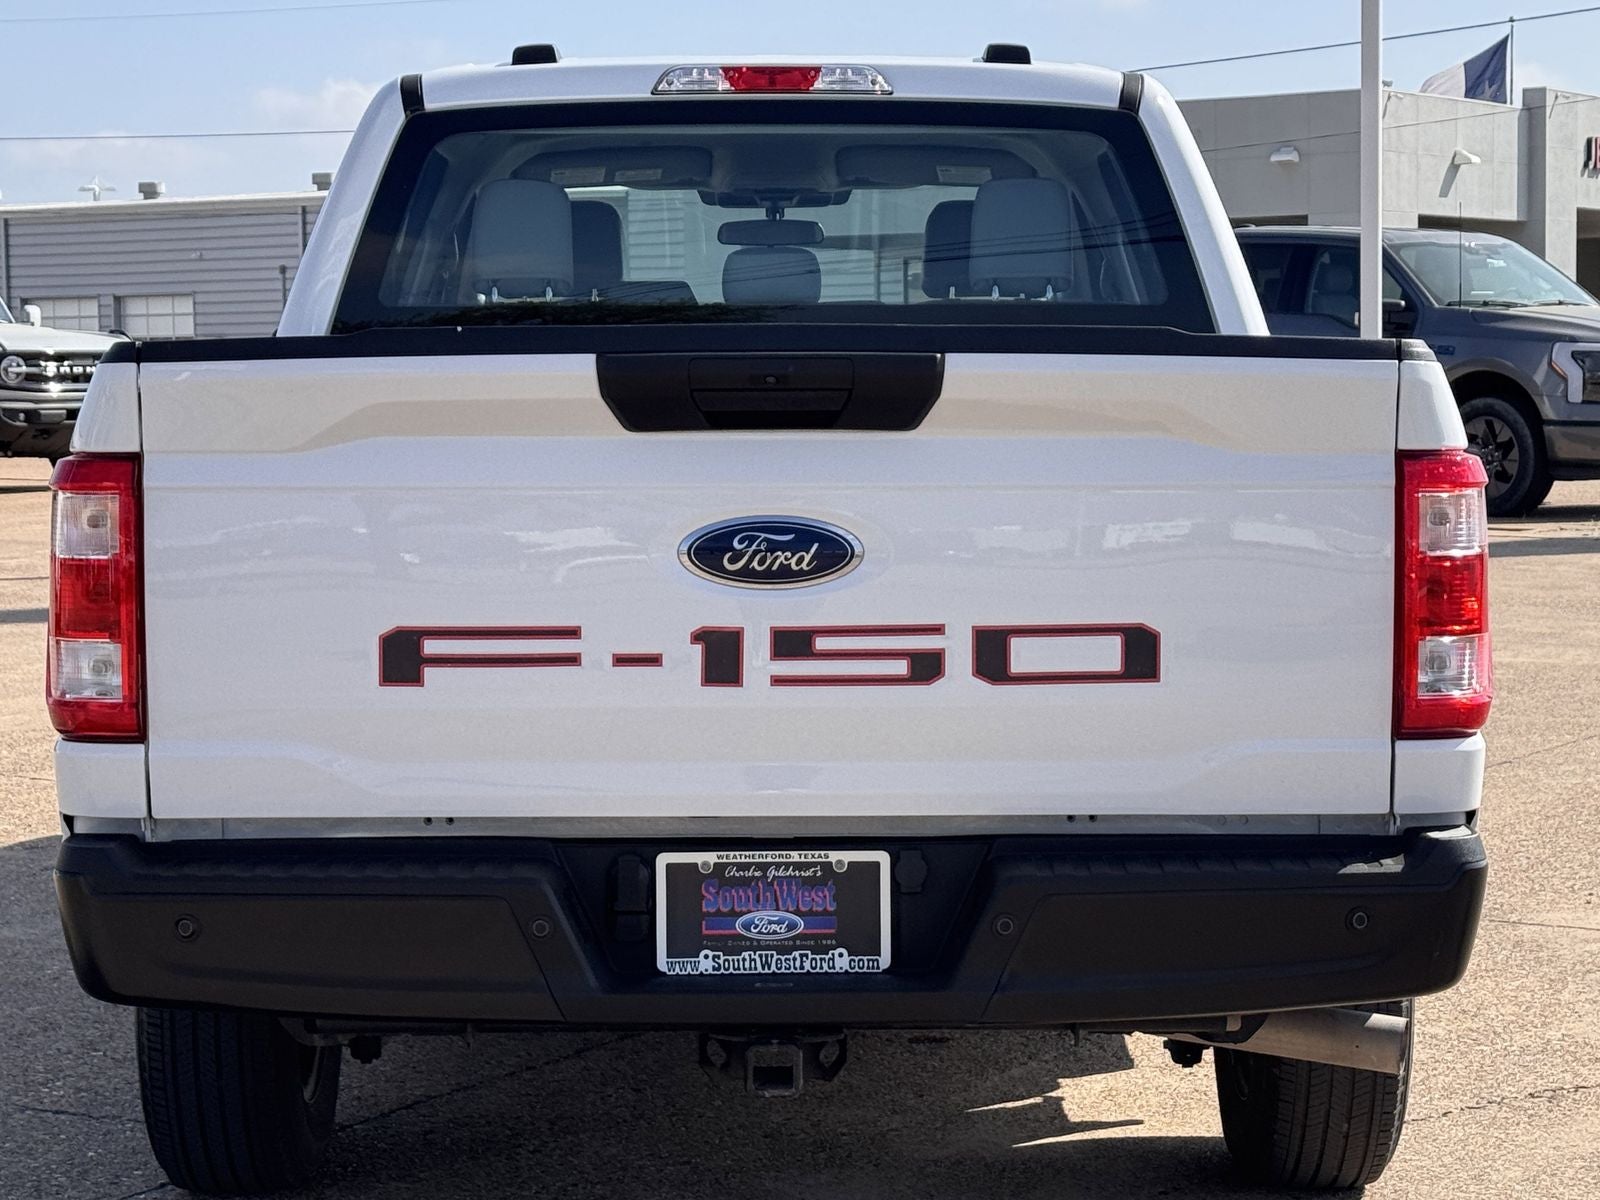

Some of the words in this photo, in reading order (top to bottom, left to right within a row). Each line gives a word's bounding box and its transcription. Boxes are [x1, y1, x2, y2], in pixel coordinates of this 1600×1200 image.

[722, 531, 820, 571] Ford
[379, 623, 1161, 687] F-150
[797, 852, 830, 860] TEXAS
[724, 865, 763, 878] Charlie
[766, 864, 823, 882] Gilchrist's
[702, 879, 837, 913] SouthWest
[750, 915, 788, 934] Ford
